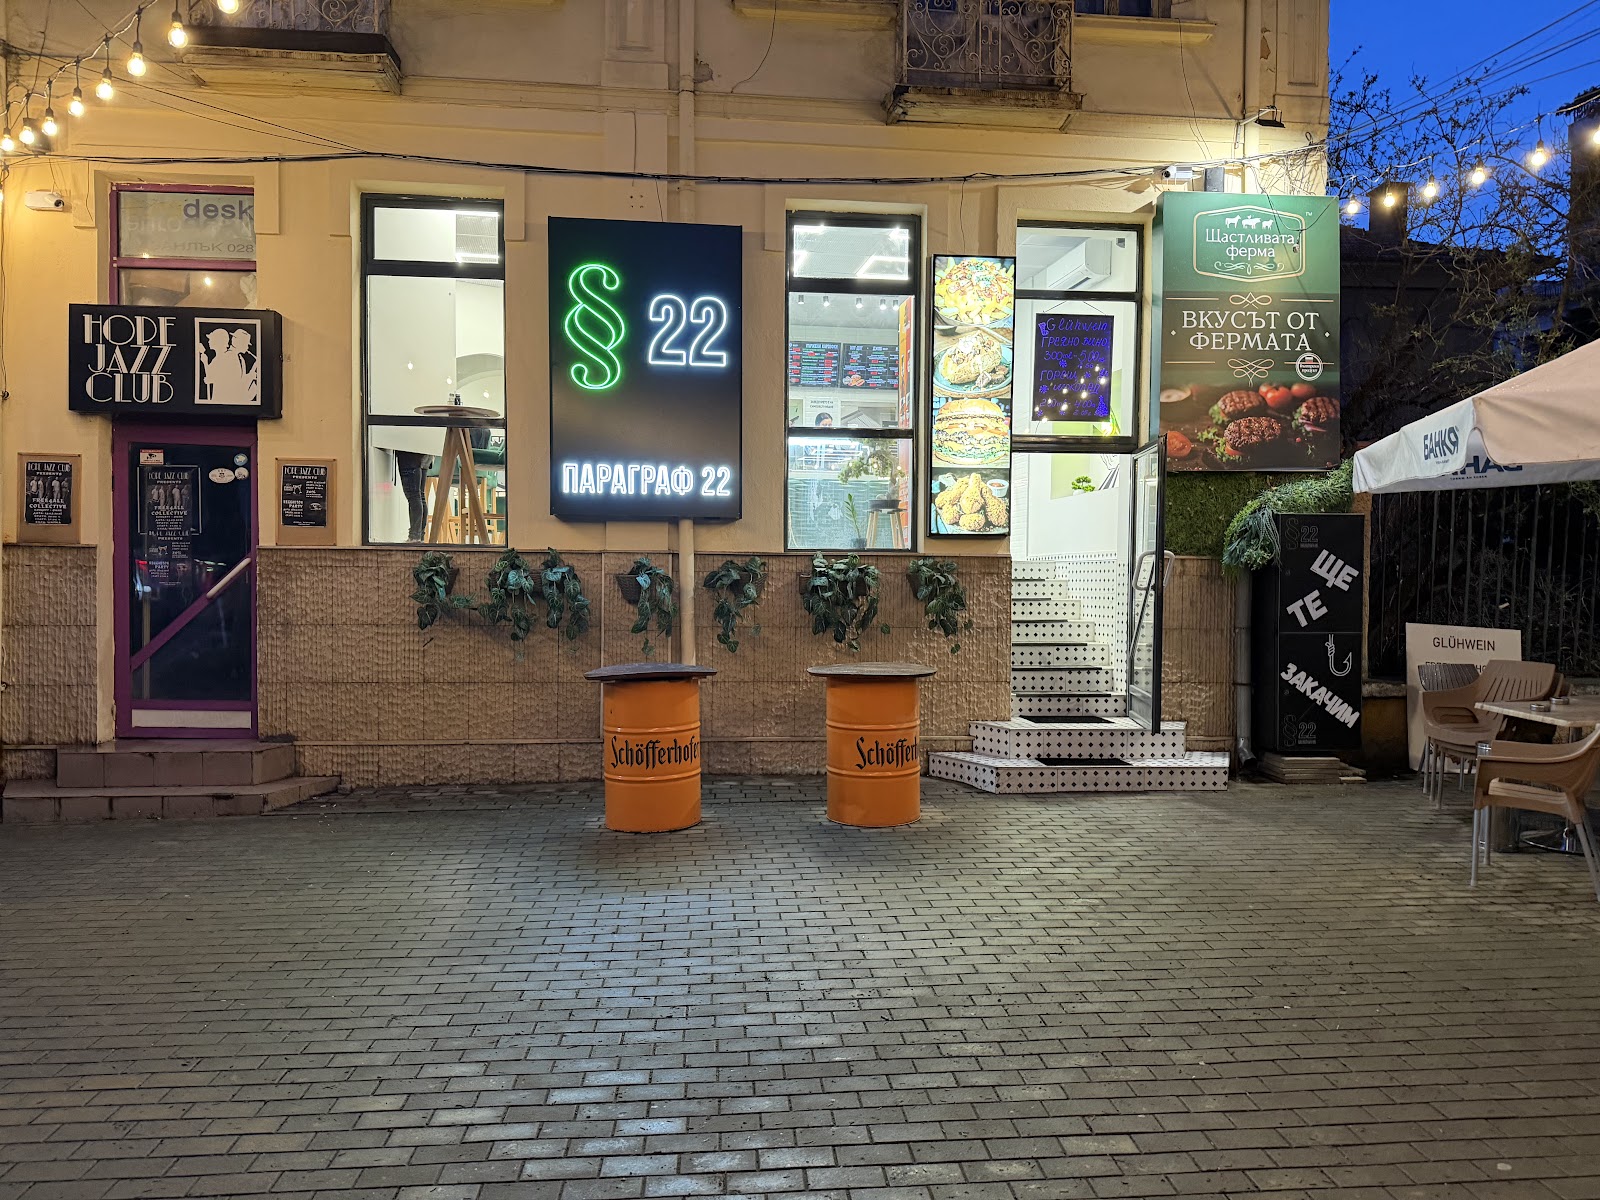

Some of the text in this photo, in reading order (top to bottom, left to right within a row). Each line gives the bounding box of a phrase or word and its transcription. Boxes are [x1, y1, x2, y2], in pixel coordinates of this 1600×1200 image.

[183, 199, 254, 220] desk
[227, 242, 254, 253] 028
[1205, 228, 1295, 244] Щастливата
[1226, 246, 1275, 260] ферма
[83, 315, 177, 346] HOPE
[648, 294, 728, 367] 22
[1181, 310, 1319, 330] ВКУСЪТ ОТ
[1189, 332, 1312, 351] ФЕРМАТА
[88, 344, 173, 375] JAZZ
[85, 372, 174, 404] CLUB
[562, 463, 731, 496] ПАРАГРАФ 22
[1309, 549, 1360, 591] ЩЕ
[1286, 589, 1329, 628] ТЕ
[1432, 635, 1496, 652] GLÜHWEIN
[1280, 662, 1361, 729] ЗАКАЧИМ
